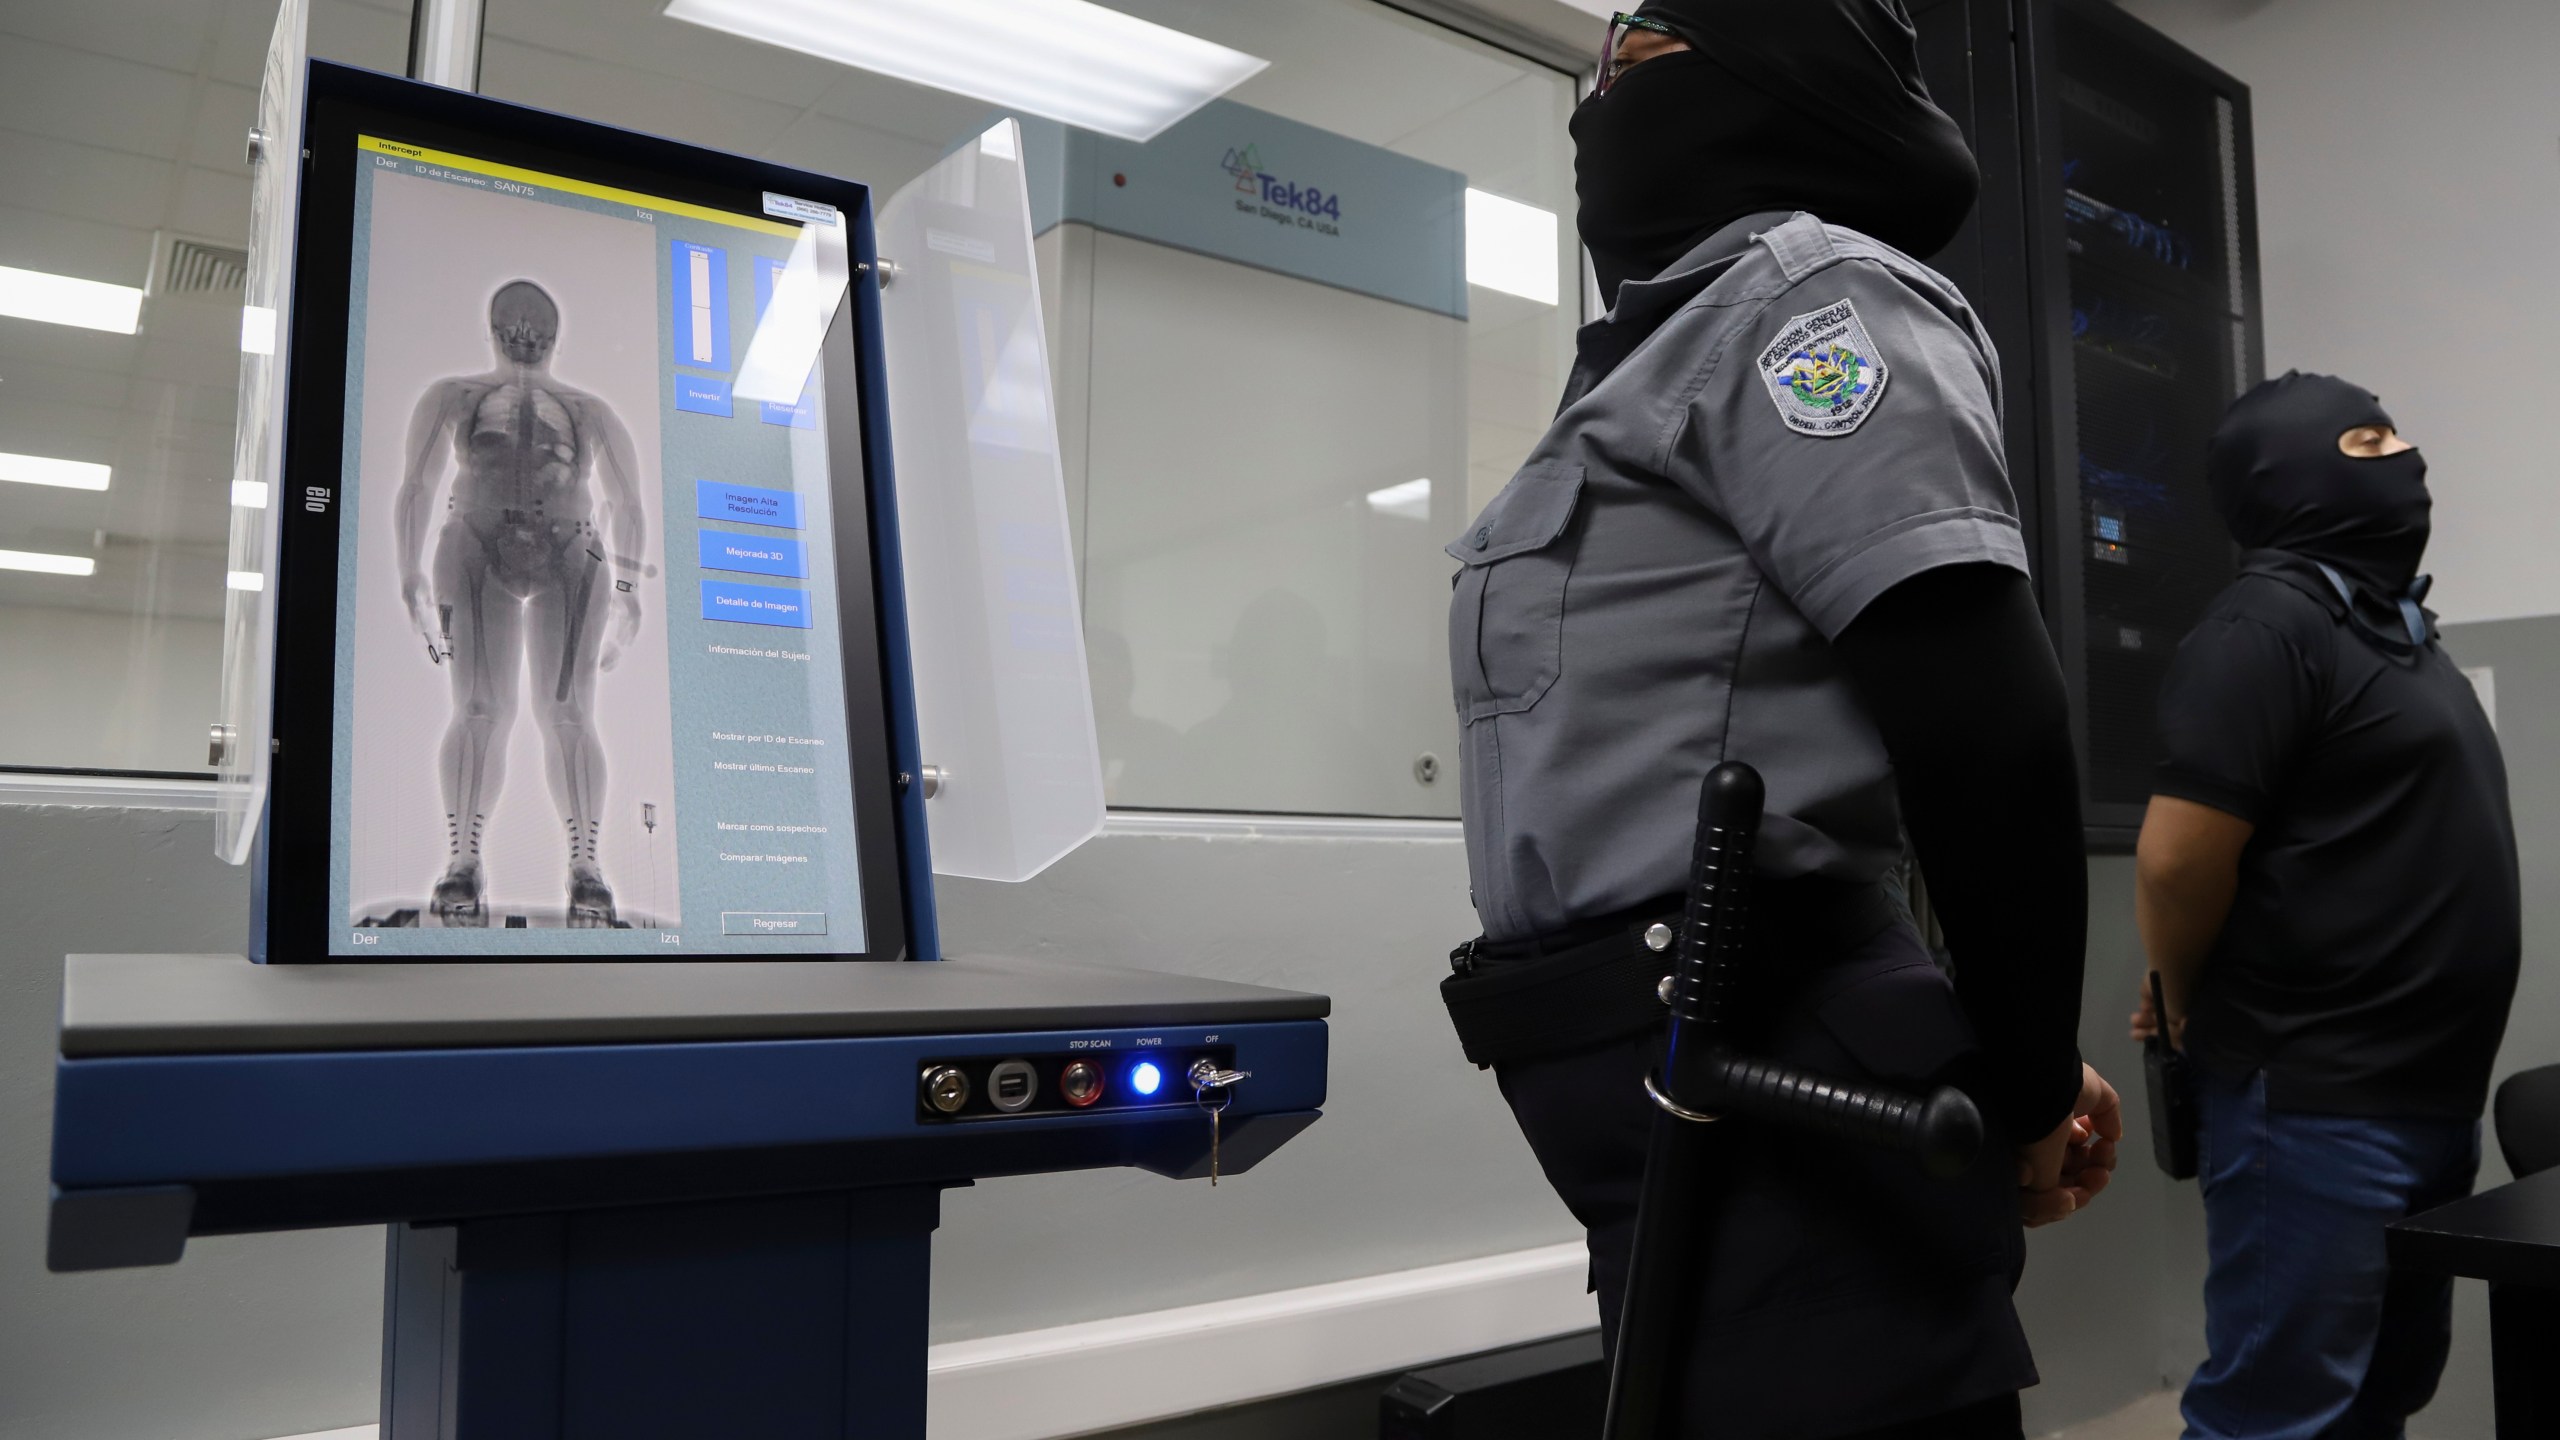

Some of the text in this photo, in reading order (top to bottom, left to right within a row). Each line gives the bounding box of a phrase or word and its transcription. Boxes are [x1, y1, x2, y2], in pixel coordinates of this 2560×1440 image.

[378, 141, 422, 157] Intercept
[376, 156, 398, 169] Der
[415, 164, 427, 174] ID
[428, 168, 441, 177] de
[494, 180, 535, 196] SAN75
[1255, 172, 1341, 221] Tek84
[636, 208, 653, 222] Izq
[1235, 199, 1340, 237] San Diego, CA USA
[1805, 304, 1849, 330] GENERAL
[1774, 331, 1811, 361] CENTROS
[688, 389, 721, 402] Invertir
[768, 402, 808, 416] Resetear
[1788, 415, 1817, 430] ORDEN
[1824, 410, 1863, 429] CONTROL
[725, 492, 778, 507] Imagen Alta
[727, 503, 778, 517] Resolución
[726, 546, 784, 561] Mejorada 3D
[716, 596, 798, 613] Detalle de Imagen
[708, 644, 811, 662] Información del Sujeto
[712, 731, 825, 746] Mostrar por ID de Escaneo
[714, 761, 815, 774] Mostrar último Escaneo
[717, 821, 828, 835] Marcar como sospechoso
[719, 852, 808, 864] Comparar Imágenes
[753, 918, 798, 931] Regresar
[352, 932, 380, 945] Der
[661, 932, 680, 946] Izq
[1069, 1039, 1111, 1049] STOP SCAN
[1136, 1037, 1162, 1047] POWER
[1205, 1035, 1219, 1043] OFF
